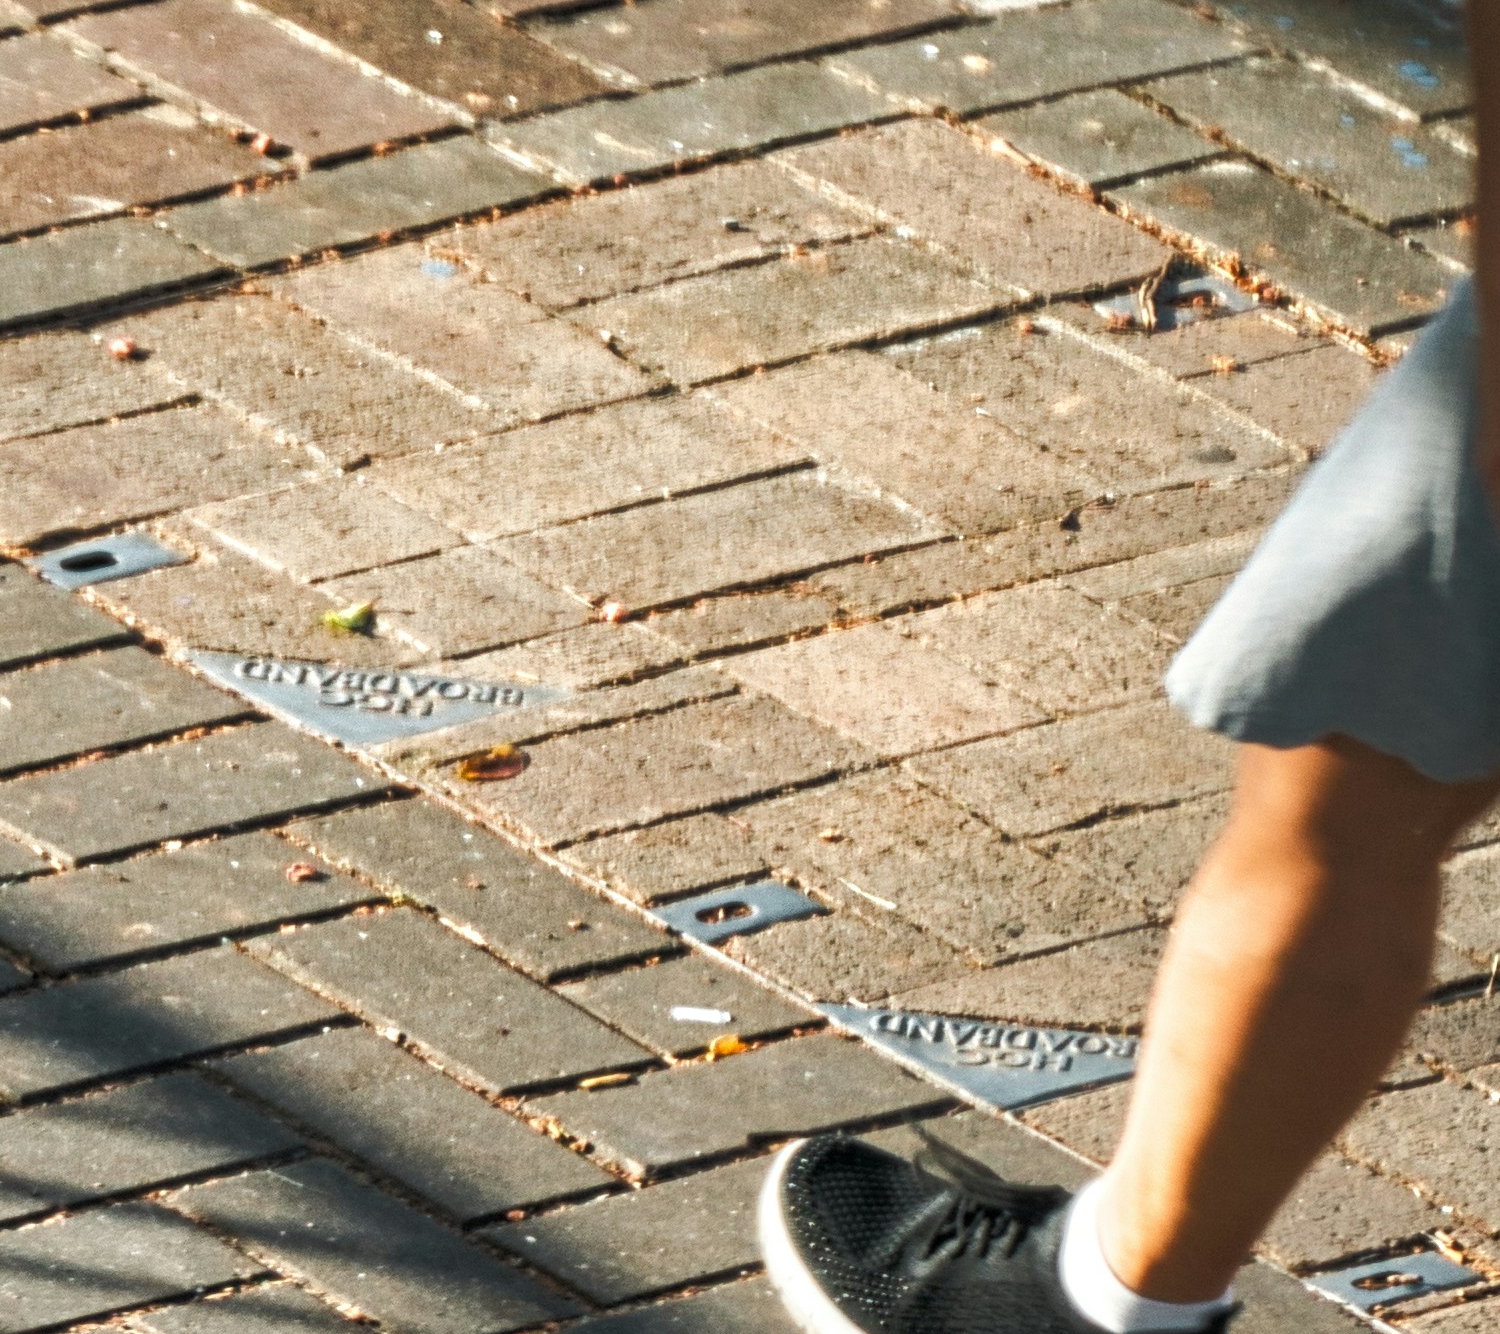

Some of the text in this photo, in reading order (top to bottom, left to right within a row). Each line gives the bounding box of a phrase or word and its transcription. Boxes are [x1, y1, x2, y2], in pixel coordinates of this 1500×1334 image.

[235, 656, 524, 707] BROADBAND
[869, 1014, 1138, 1058] ROADBAND
[954, 1047, 1074, 1072] HGC
